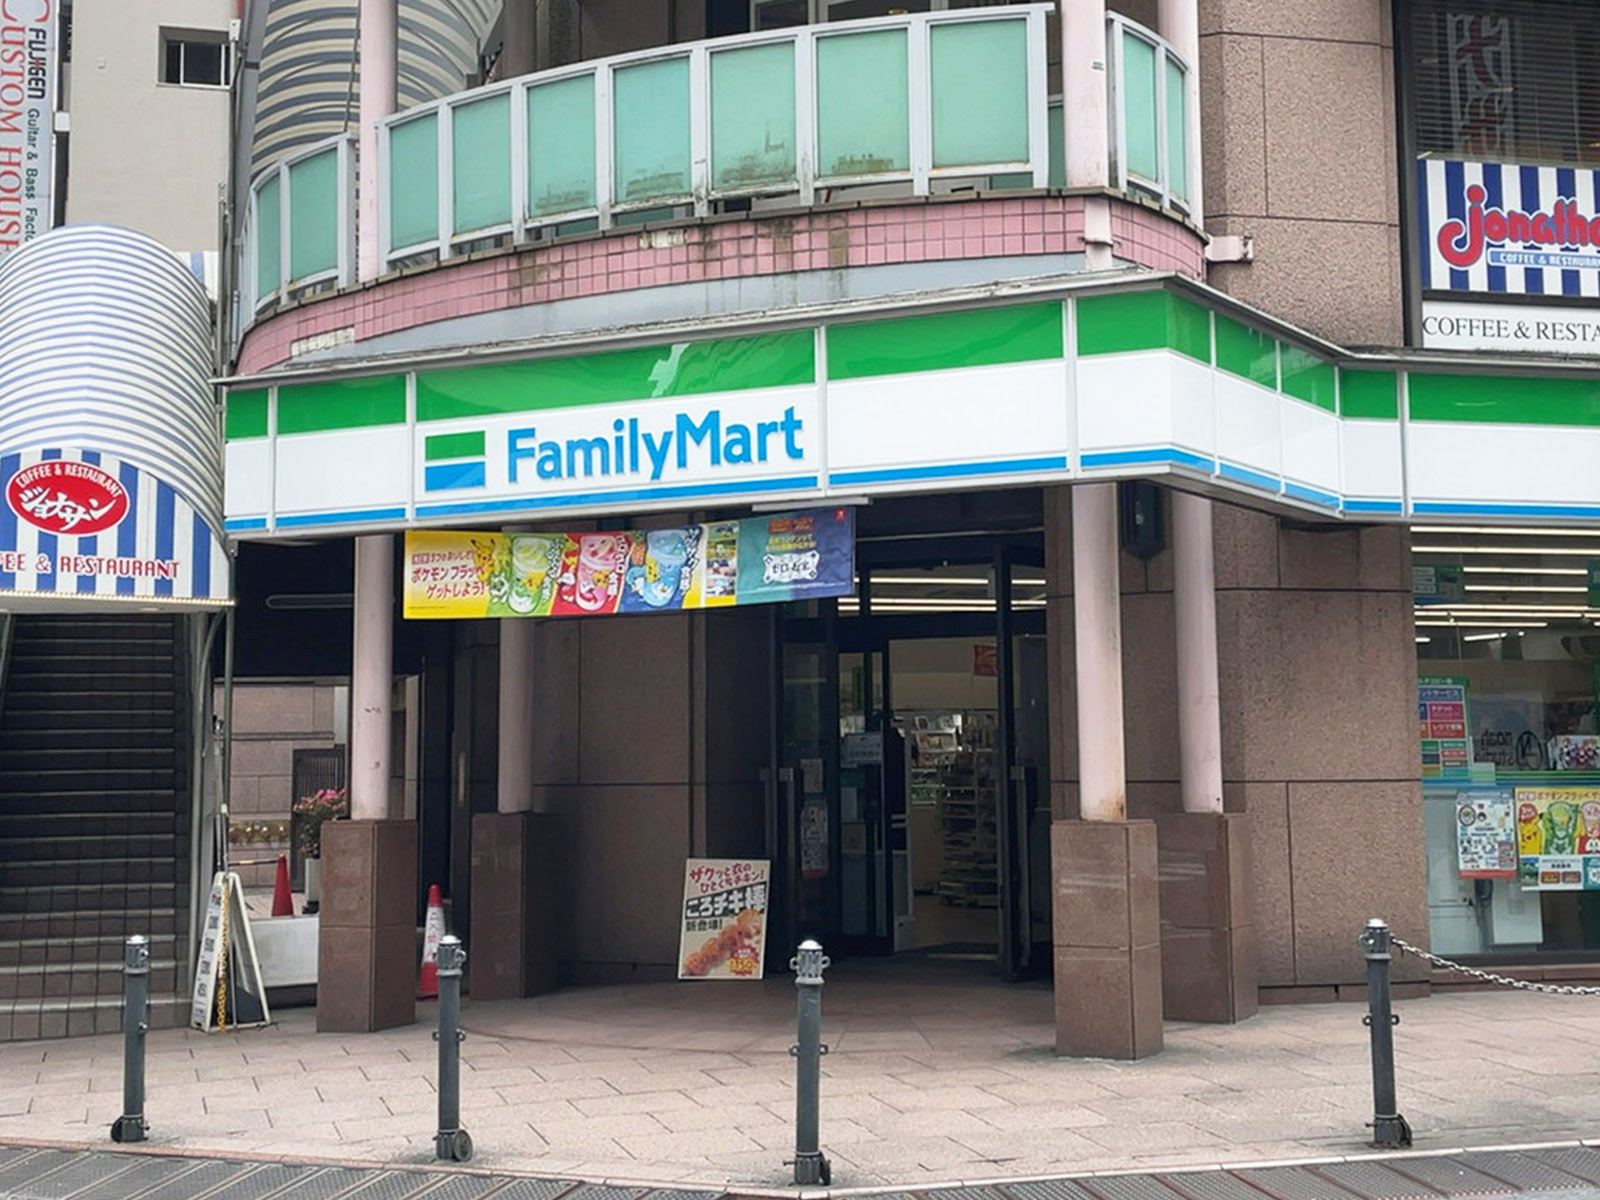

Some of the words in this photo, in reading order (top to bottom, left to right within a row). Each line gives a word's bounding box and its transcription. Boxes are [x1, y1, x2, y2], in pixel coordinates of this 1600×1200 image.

[28, 27, 47, 99] FUJIGEN
[27, 108, 40, 148] Guitar
[26, 151, 38, 160] &
[25, 168, 38, 200] Bass
[1500, 252, 1535, 264] COFFEE
[1422, 316, 1510, 339] COFFEE
[1514, 320, 1531, 340] &
[507, 405, 804, 484] FamilyMart
[16, 464, 51, 488] COFFEE
[54, 463, 63, 476] &
[65, 463, 123, 498] RESTAURANT
[35, 555, 49, 571] &
[60, 556, 180, 578] RESTAURANT
